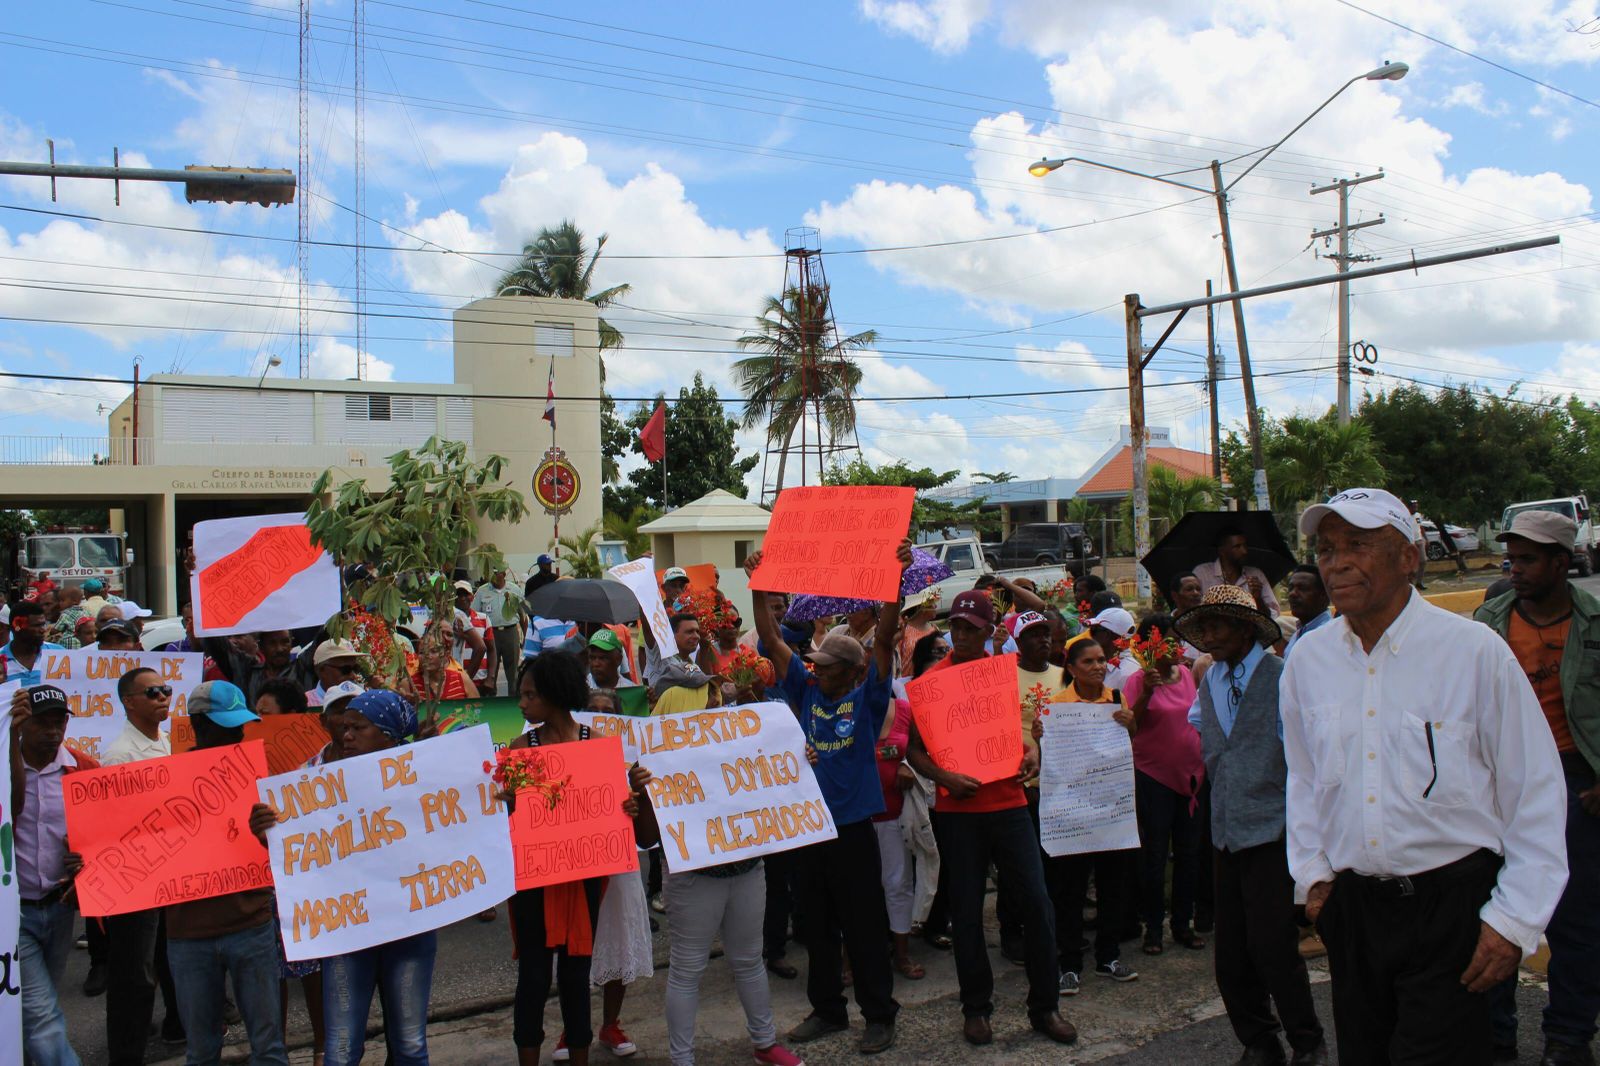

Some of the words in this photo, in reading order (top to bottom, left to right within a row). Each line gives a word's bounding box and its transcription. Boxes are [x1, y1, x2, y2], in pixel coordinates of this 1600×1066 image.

[212, 469, 250, 479] CUERPO
[254, 471, 265, 479] DE
[868, 507, 899, 530] AND
[831, 537, 889, 565] DON'T
[850, 567, 885, 598] YOU
[46, 655, 71, 680] LA
[161, 657, 185, 681] DE
[168, 693, 188, 717] A
[911, 676, 945, 708] SUS
[919, 711, 934, 740] Y
[947, 692, 1006, 733] AMIGOS
[70, 766, 170, 806] DOMINGO
[266, 766, 348, 824] UNIÓN
[378, 750, 418, 792] DE
[650, 770, 705, 809] PARA
[721, 748, 801, 797] DOMINGO
[79, 743, 262, 913] FREEDOM!
[227, 818, 240, 843] &
[282, 806, 407, 876] FAMILIAS
[419, 788, 467, 833] POR
[477, 782, 504, 816] LA
[666, 821, 690, 862] Y
[706, 798, 834, 855] ALEJANDRO!
[512, 827, 633, 879] LEJANDRO!
[292, 888, 370, 943] MADRE
[400, 855, 487, 912] TIERRA
